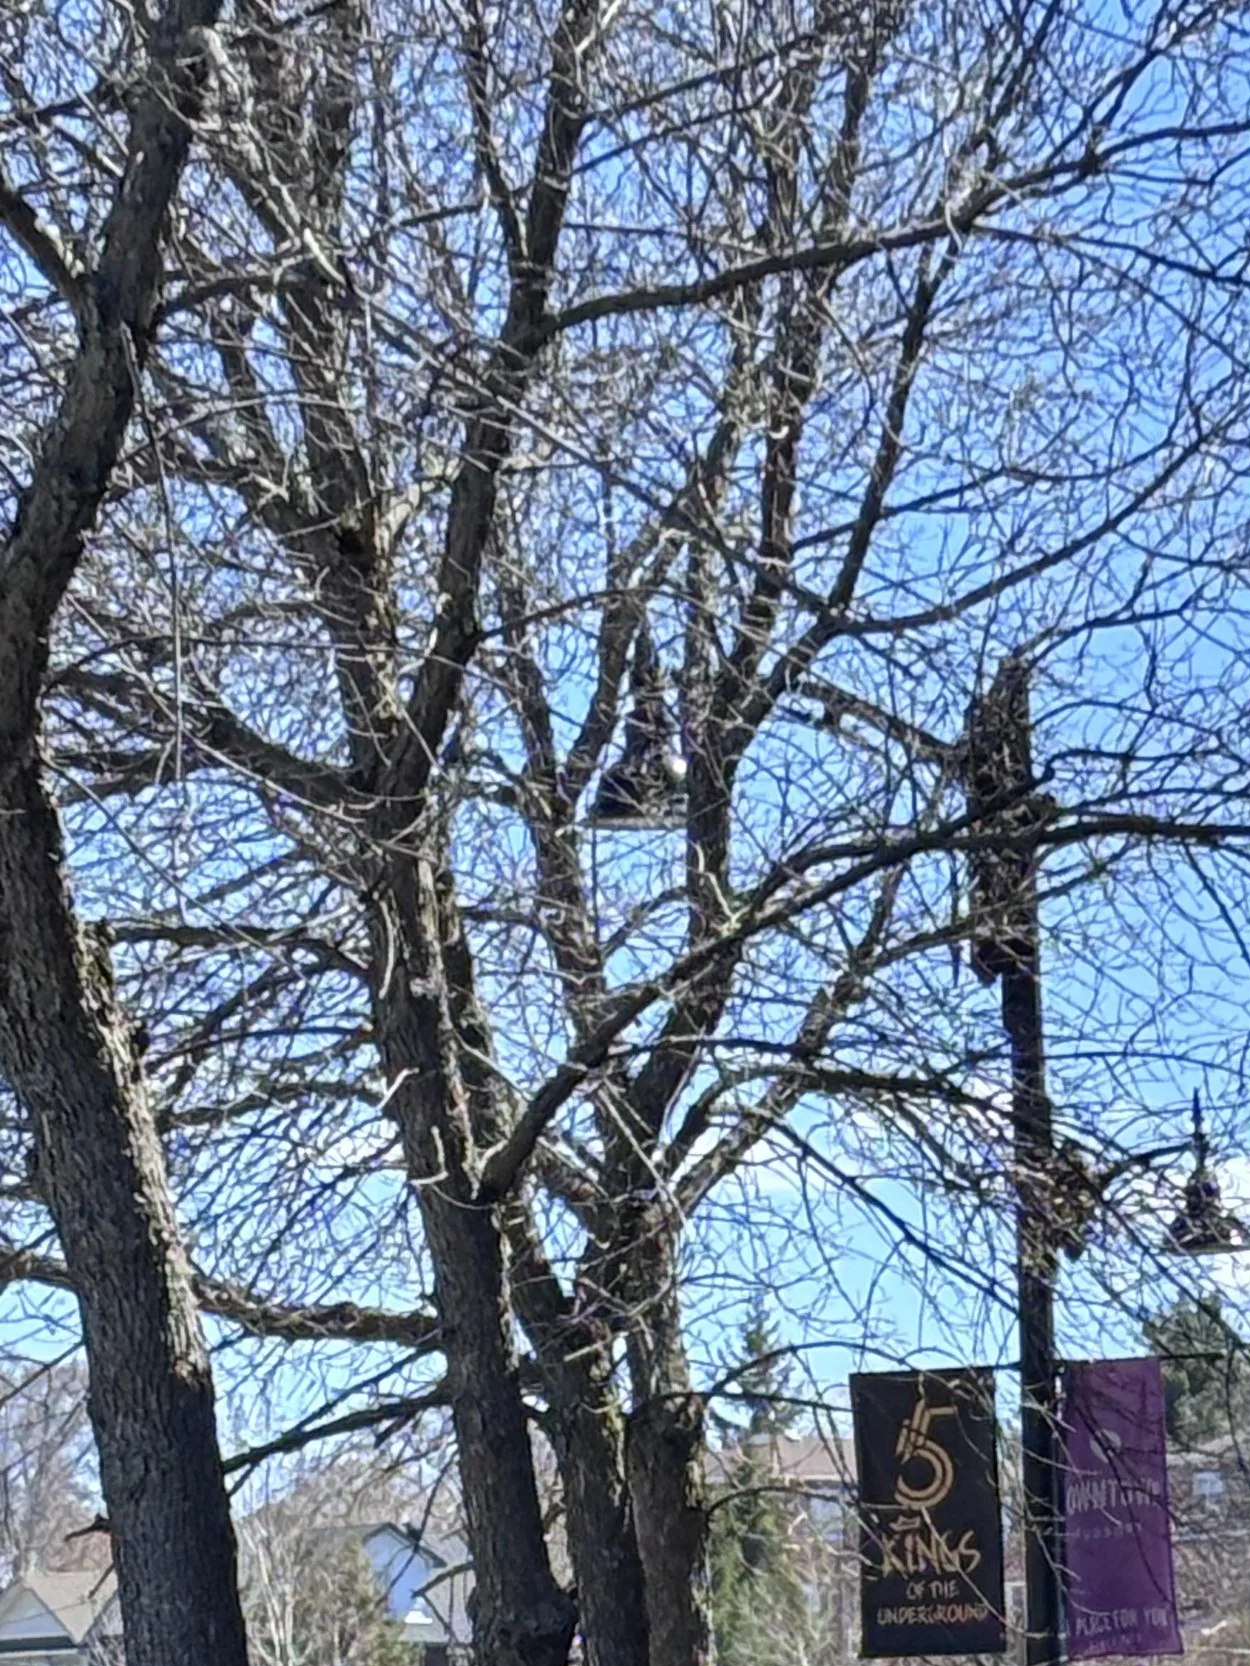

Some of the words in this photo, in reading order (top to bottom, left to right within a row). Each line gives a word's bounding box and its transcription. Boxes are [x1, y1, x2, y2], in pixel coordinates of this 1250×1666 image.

[906, 1581, 925, 1600] OF
[928, 1580, 960, 1599] THE
[876, 1602, 989, 1626] UNDERGROUND
